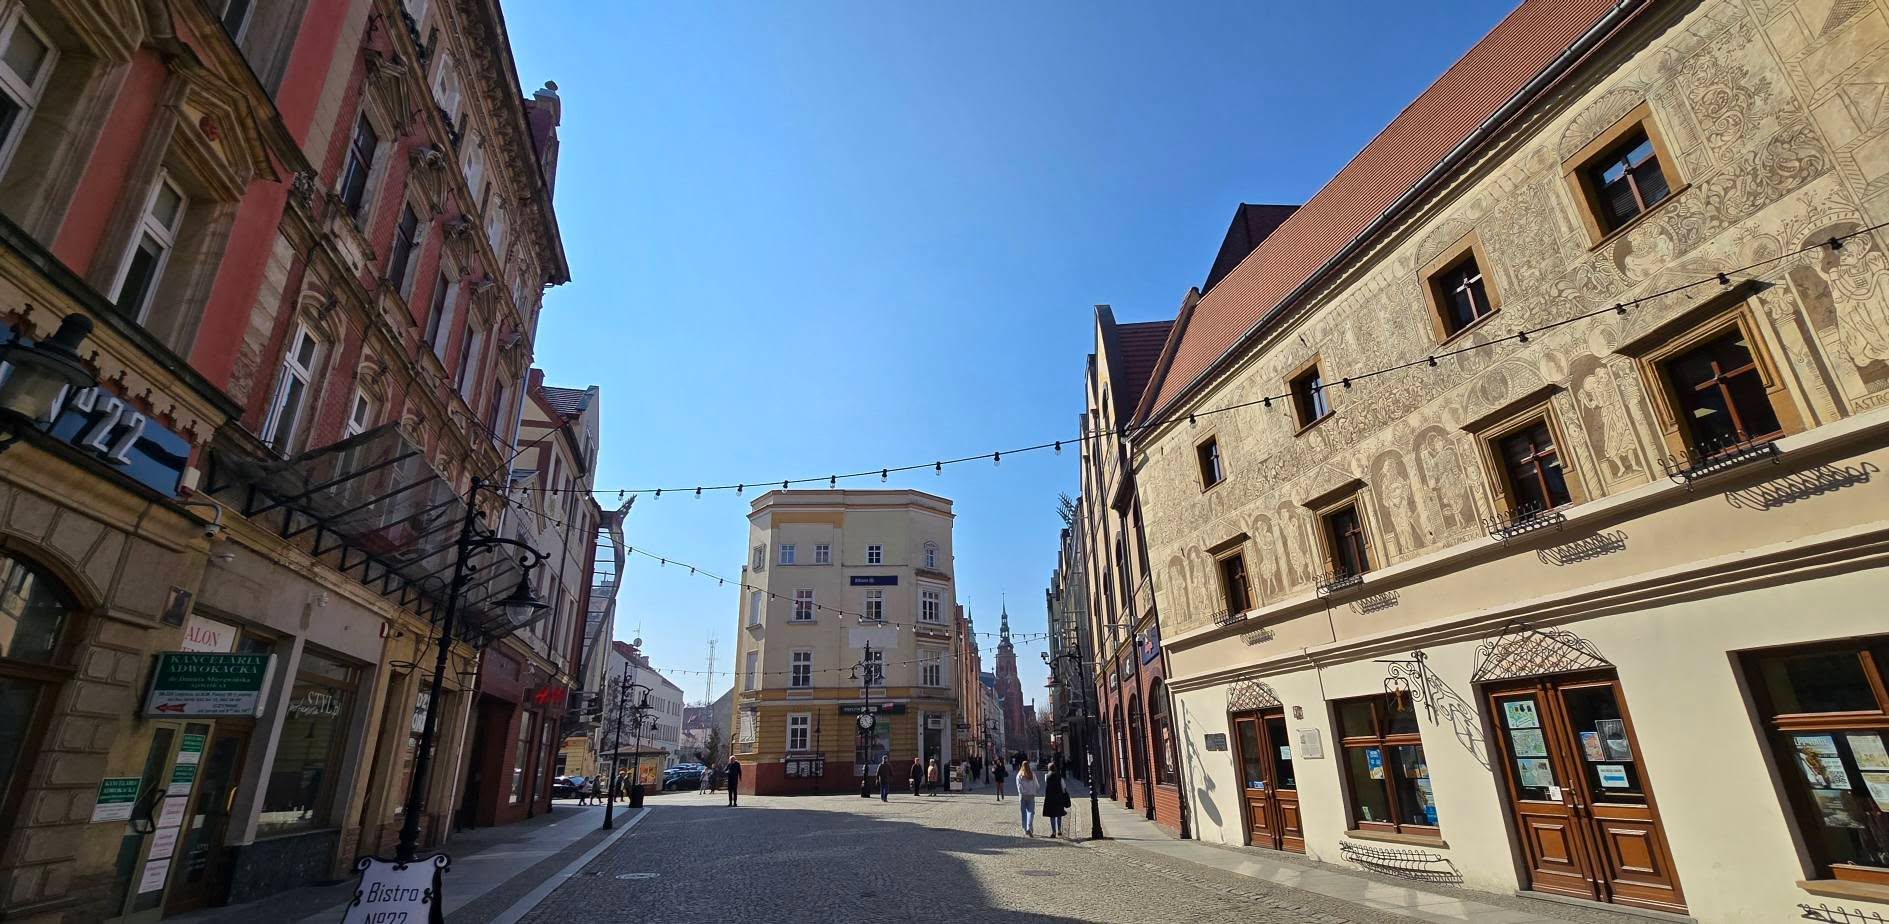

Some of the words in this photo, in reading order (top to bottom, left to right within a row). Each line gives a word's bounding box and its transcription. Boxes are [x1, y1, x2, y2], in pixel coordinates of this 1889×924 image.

[185, 626, 219, 647] ALON
[169, 655, 262, 665] KANCELARIA
[167, 665, 257, 673] ADWOKACKA
[367, 882, 420, 903] Bistro
